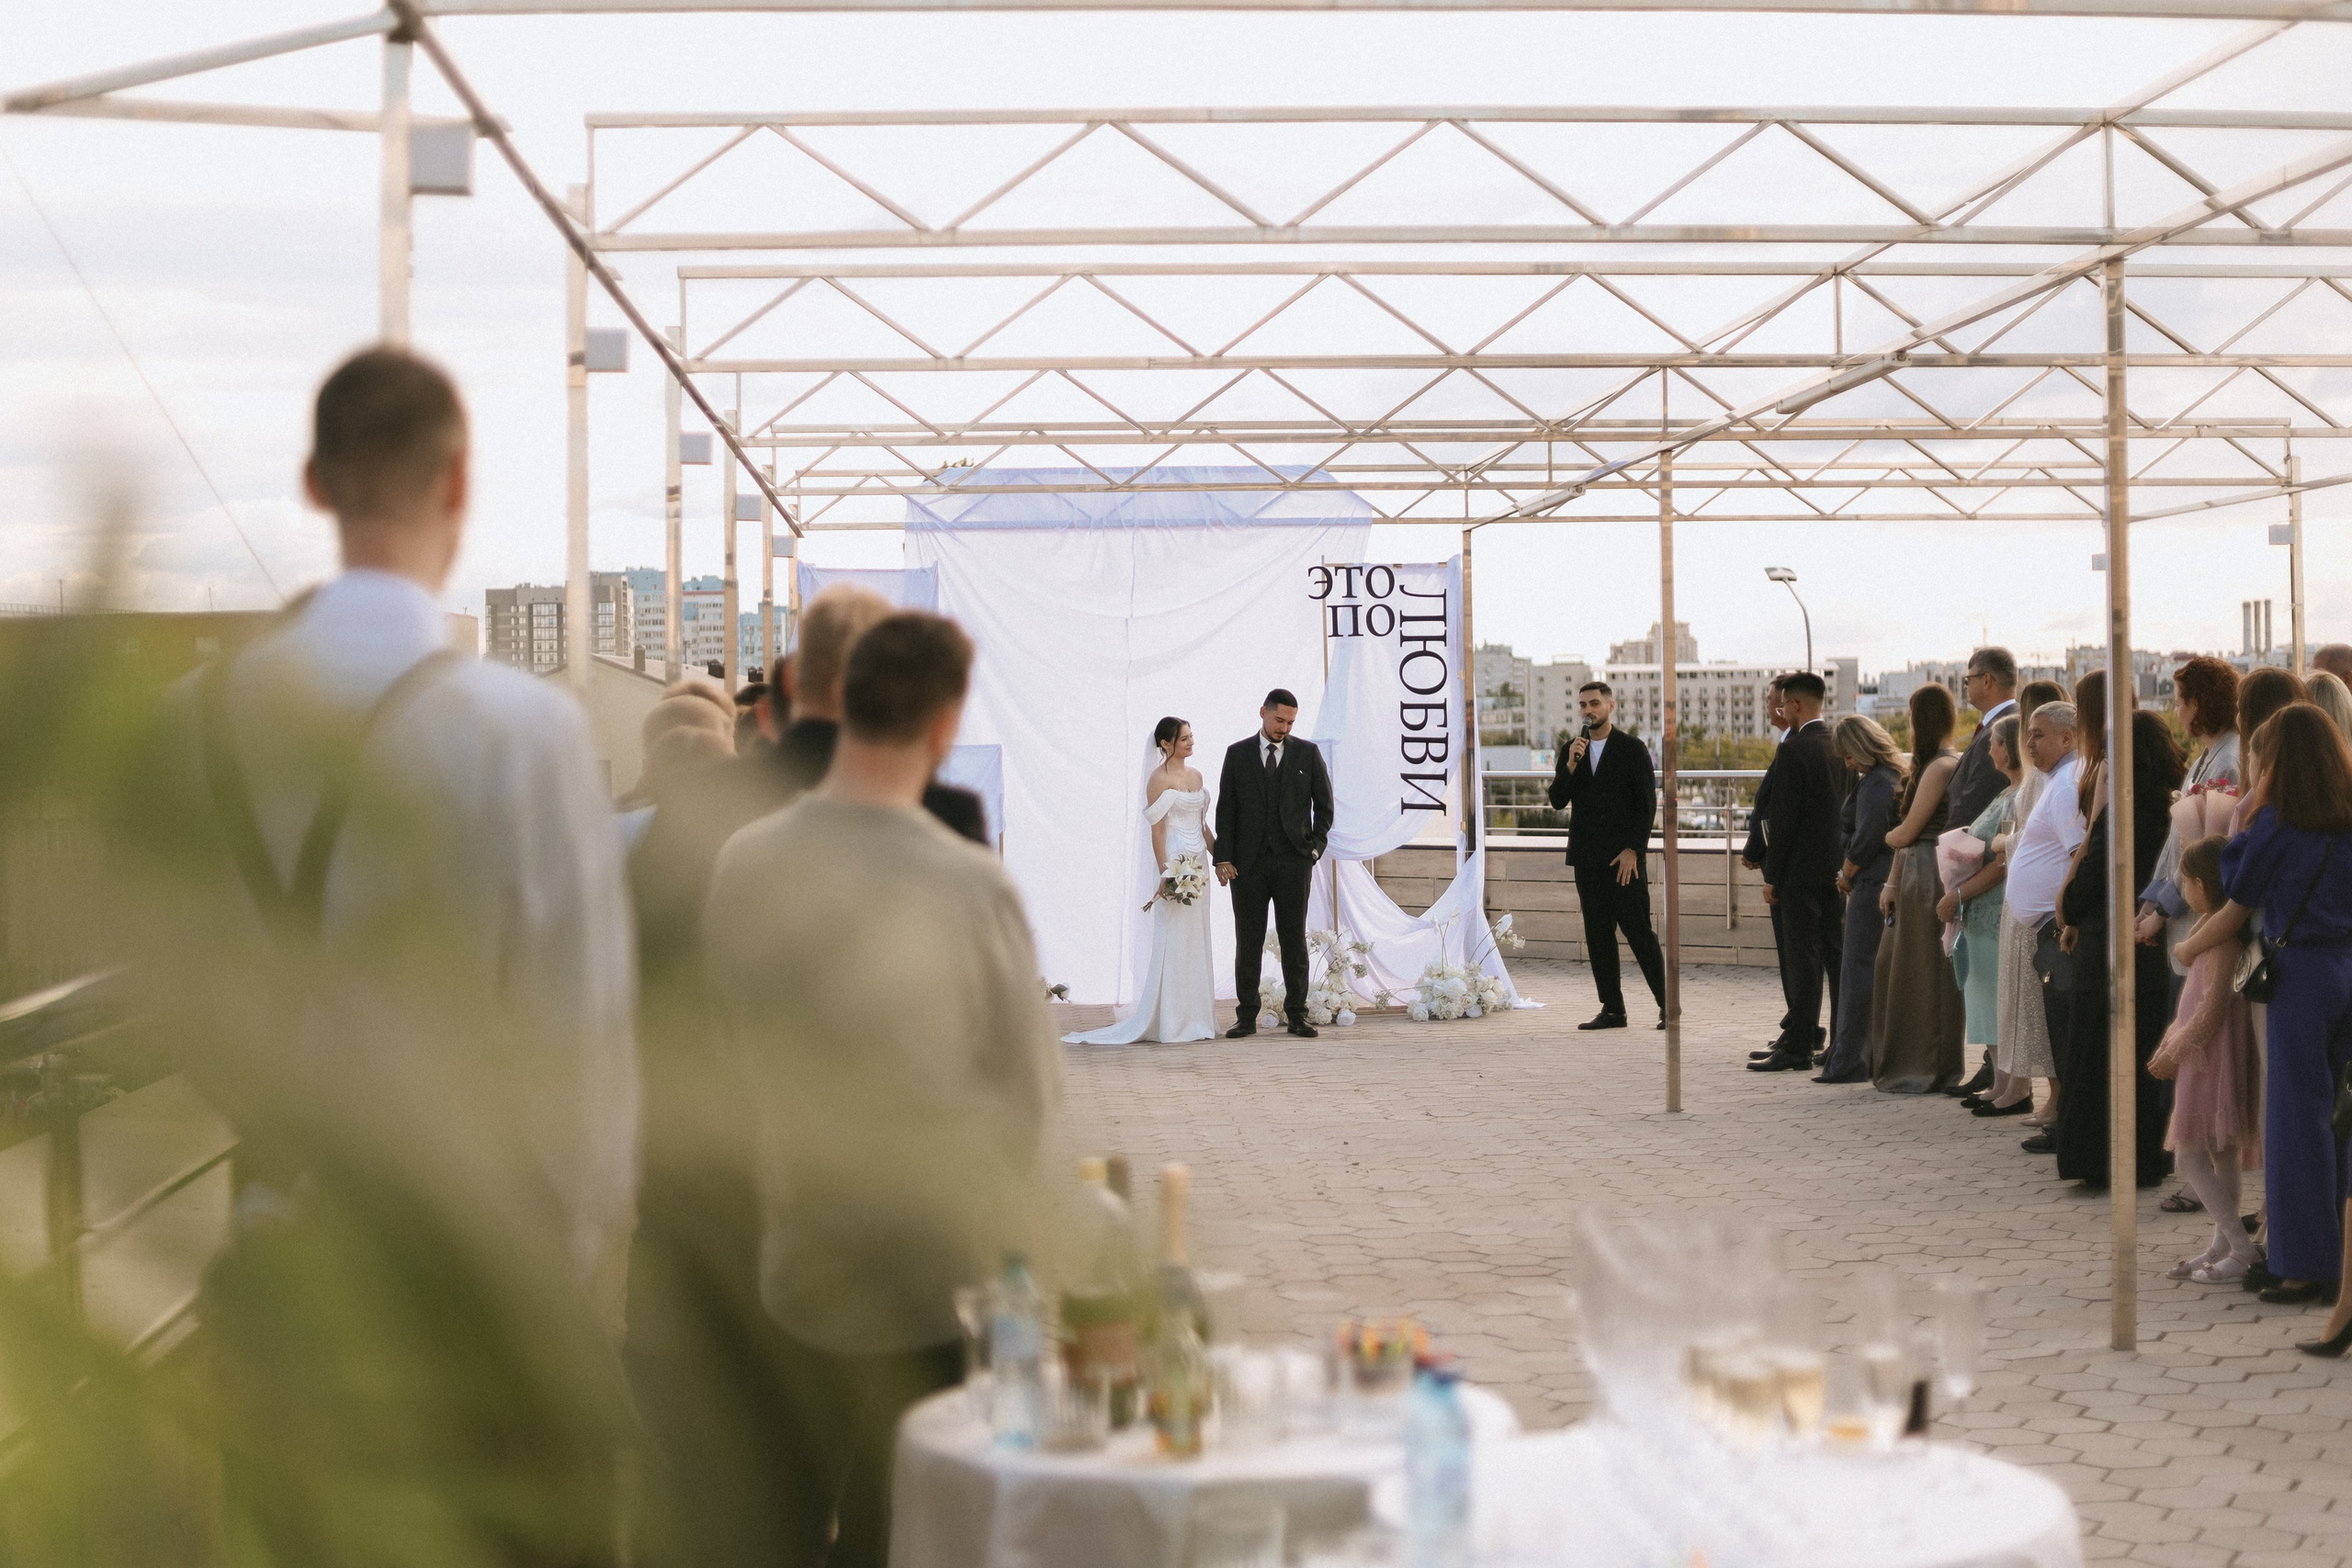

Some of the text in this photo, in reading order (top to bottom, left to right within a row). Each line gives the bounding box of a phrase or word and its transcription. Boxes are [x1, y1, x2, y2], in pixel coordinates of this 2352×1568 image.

[1307, 565, 1396, 600] ЭТО
[1326, 603, 1396, 637] ПО
[1398, 584, 1450, 817] ЛЮБВИ
